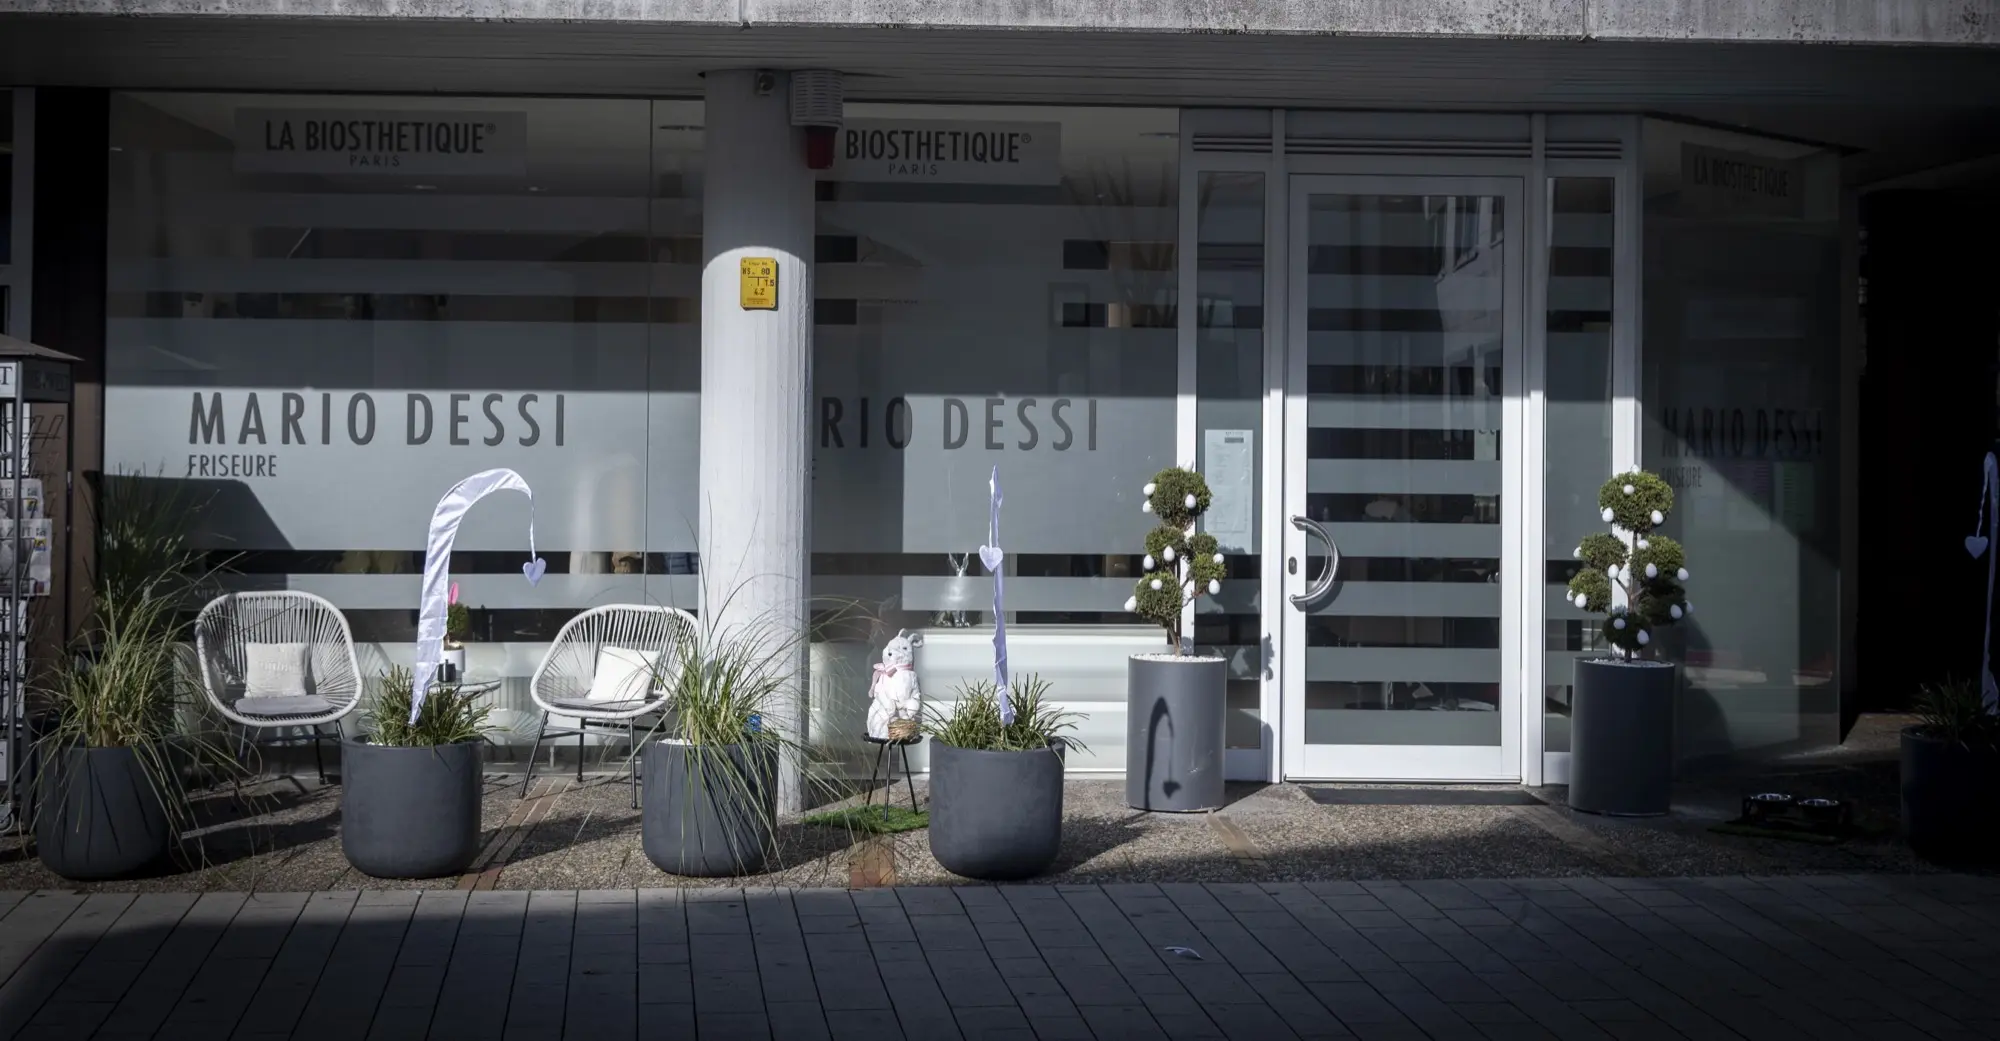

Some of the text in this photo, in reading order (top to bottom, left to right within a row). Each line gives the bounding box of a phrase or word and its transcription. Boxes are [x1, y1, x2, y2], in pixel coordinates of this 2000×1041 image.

[265, 120, 295, 151] LA
[350, 154, 401, 168] PARIS
[888, 162, 938, 176] PARIS
[1693, 154, 1708, 186] LA
[188, 391, 565, 448] MARIO DESSI
[820, 396, 1097, 452] RIO DESSI
[1662, 406, 1822, 457] MARIO DESSI
[188, 454, 278, 478] FRISEURE
